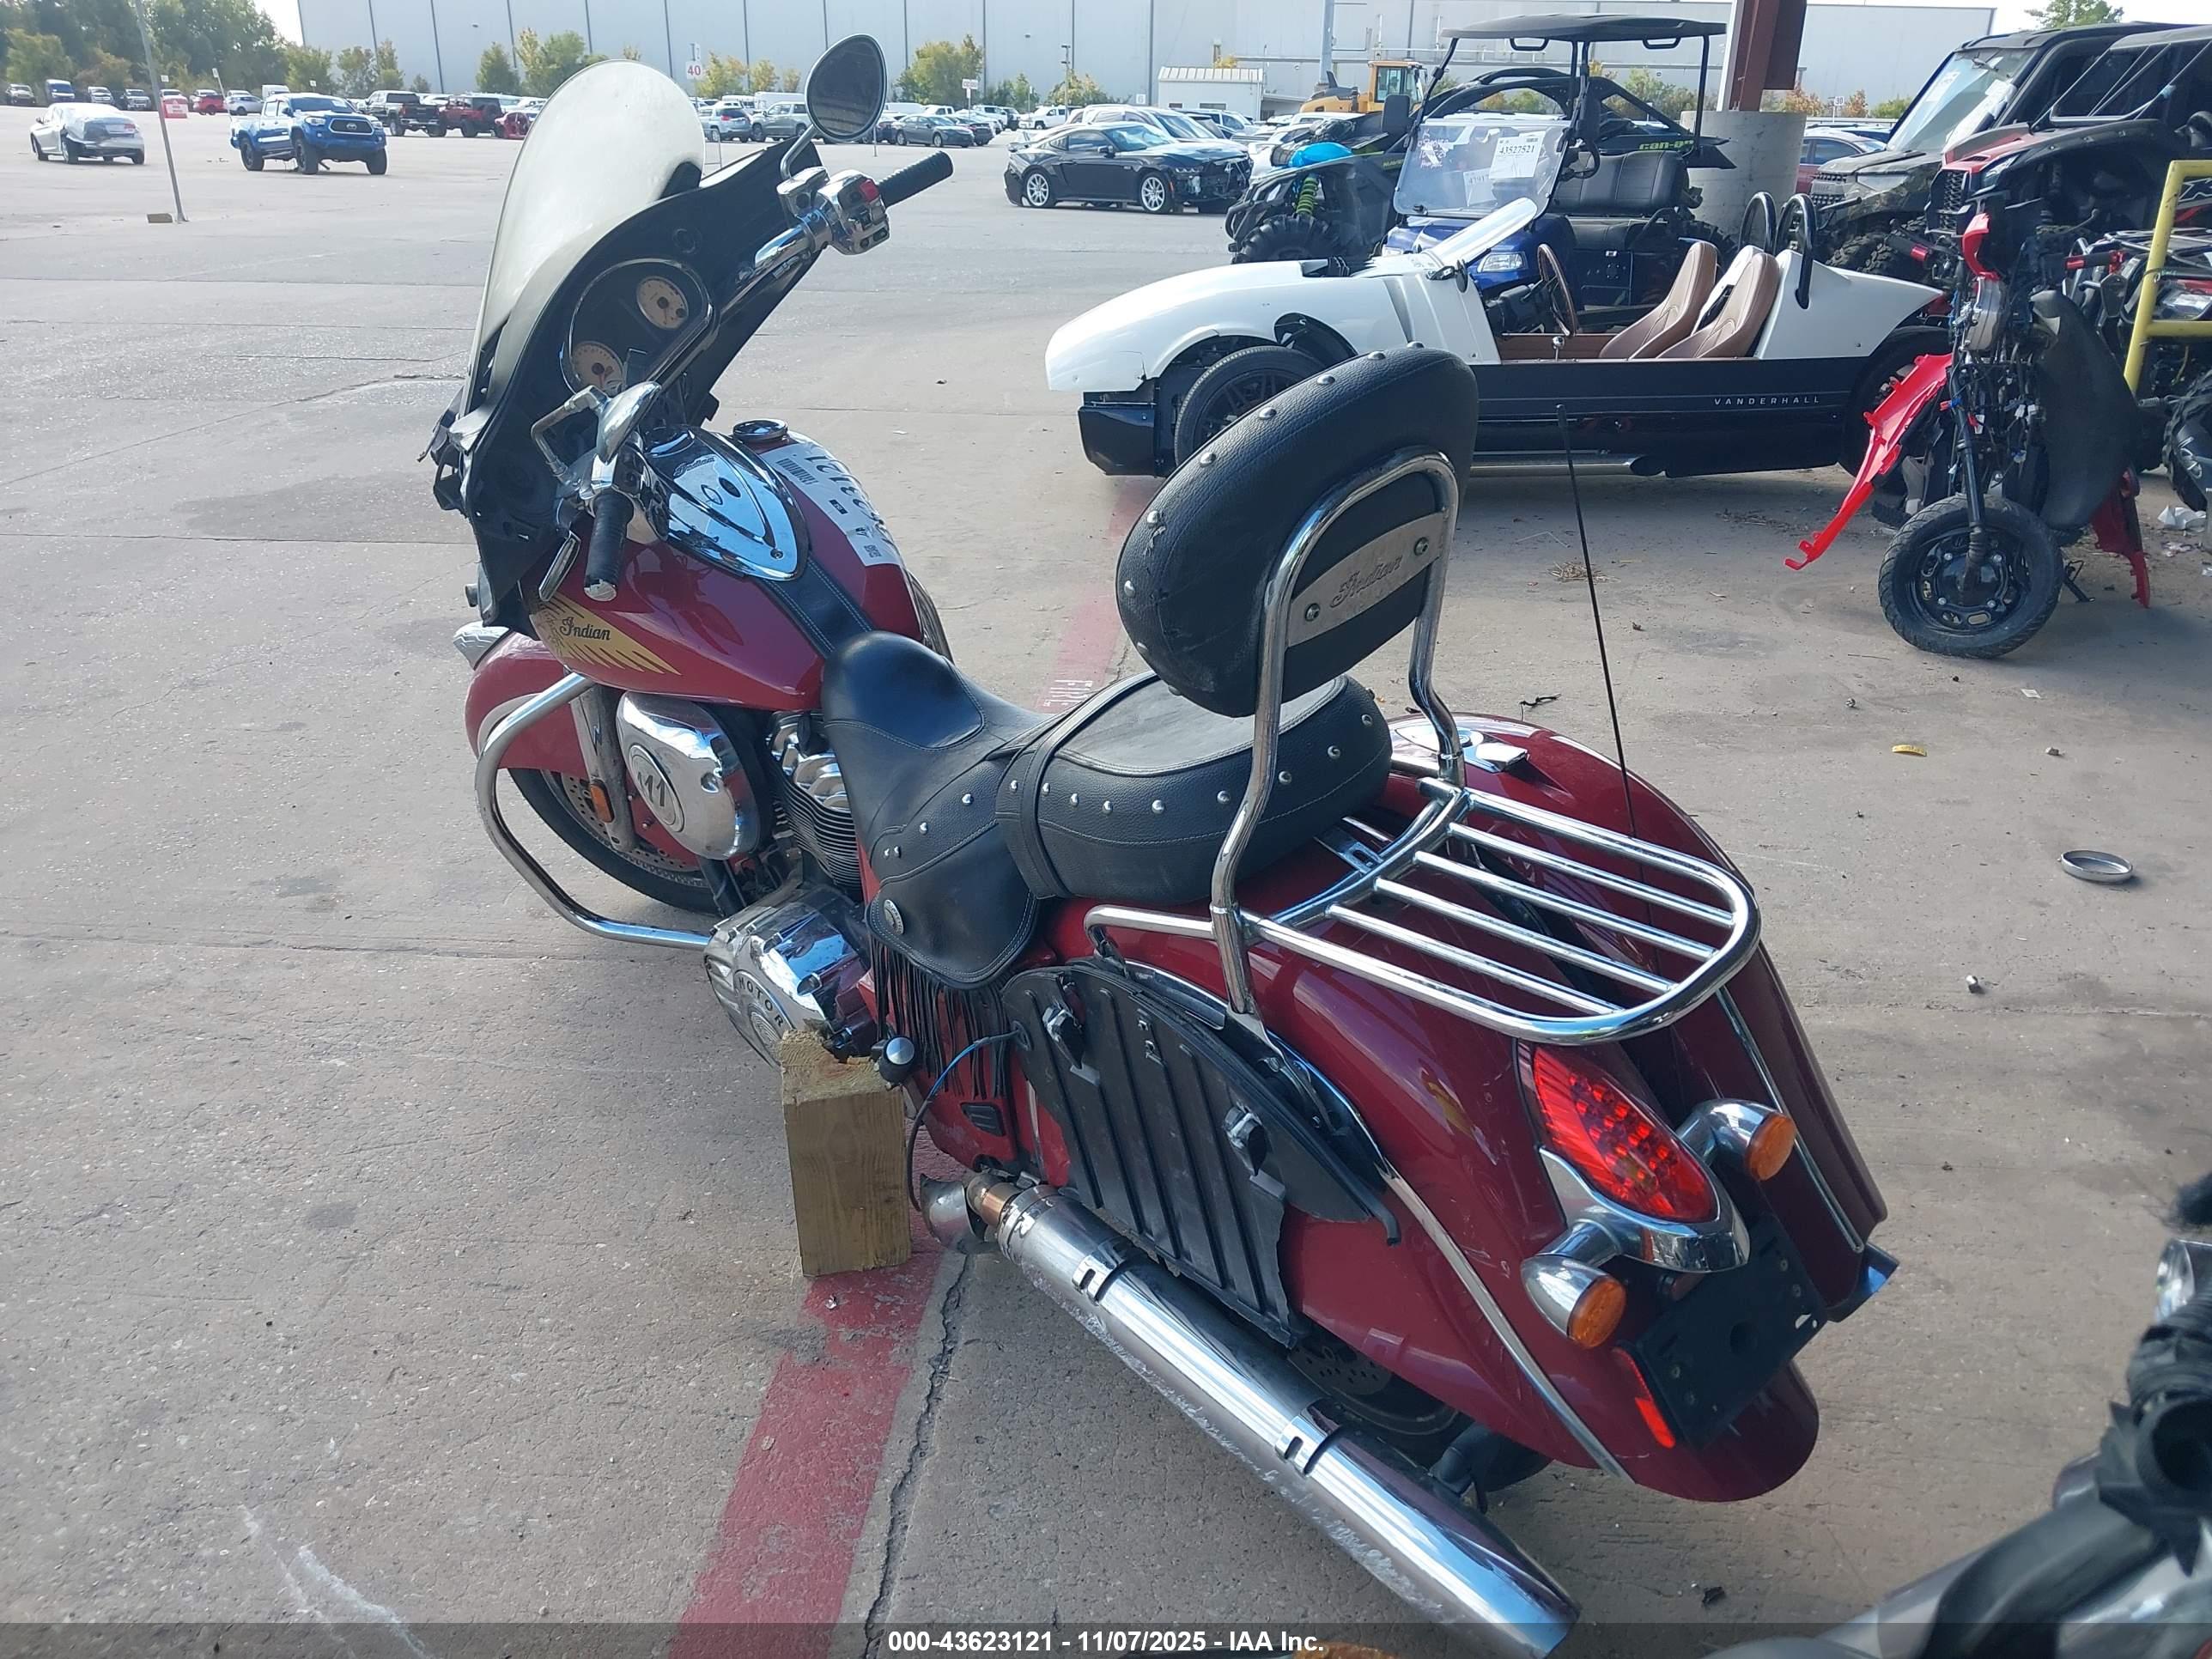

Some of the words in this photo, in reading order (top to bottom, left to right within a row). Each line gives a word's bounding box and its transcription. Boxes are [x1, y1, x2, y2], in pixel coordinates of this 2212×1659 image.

[687, 64, 702, 76] 40
[1498, 144, 1535, 155] 43527521
[1714, 396, 1820, 405] VANDERHALL
[1328, 554, 1402, 608] Indian
[559, 616, 611, 641] Indian
[738, 976, 785, 1028] MOTOR
